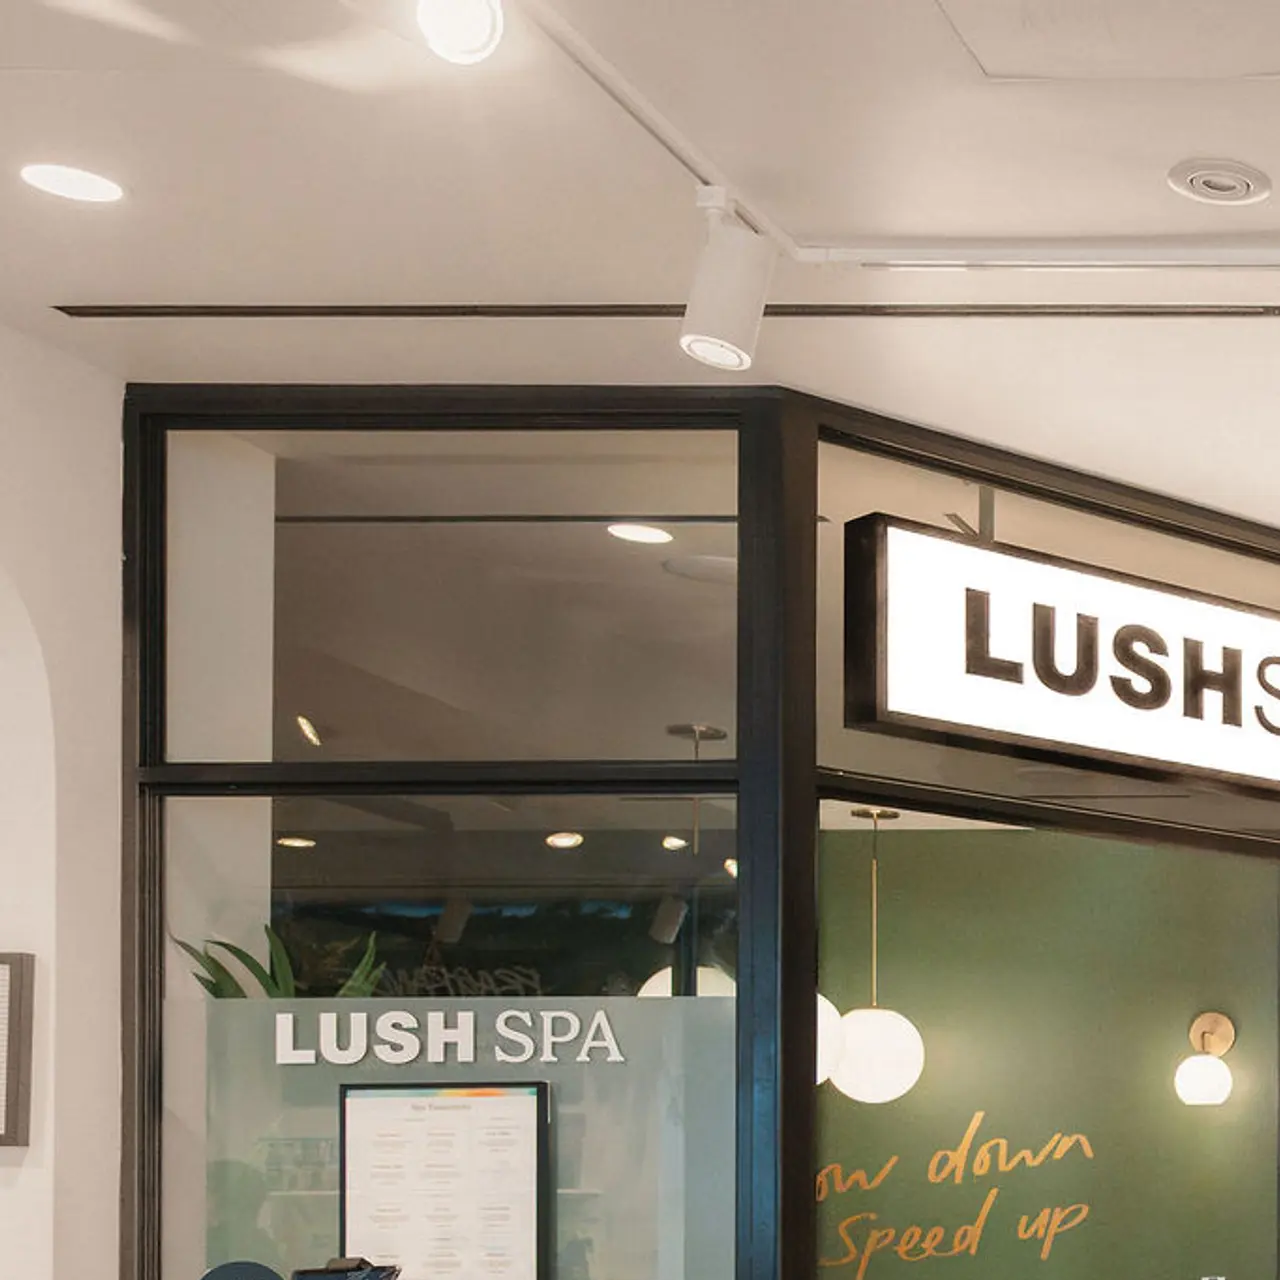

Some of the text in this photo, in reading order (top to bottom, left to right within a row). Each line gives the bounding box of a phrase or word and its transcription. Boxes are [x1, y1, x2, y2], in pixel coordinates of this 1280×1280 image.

[275, 1009, 626, 1065] LUSH SPA
[928, 1110, 1094, 1184] down
[1017, 1203, 1089, 1261] up
